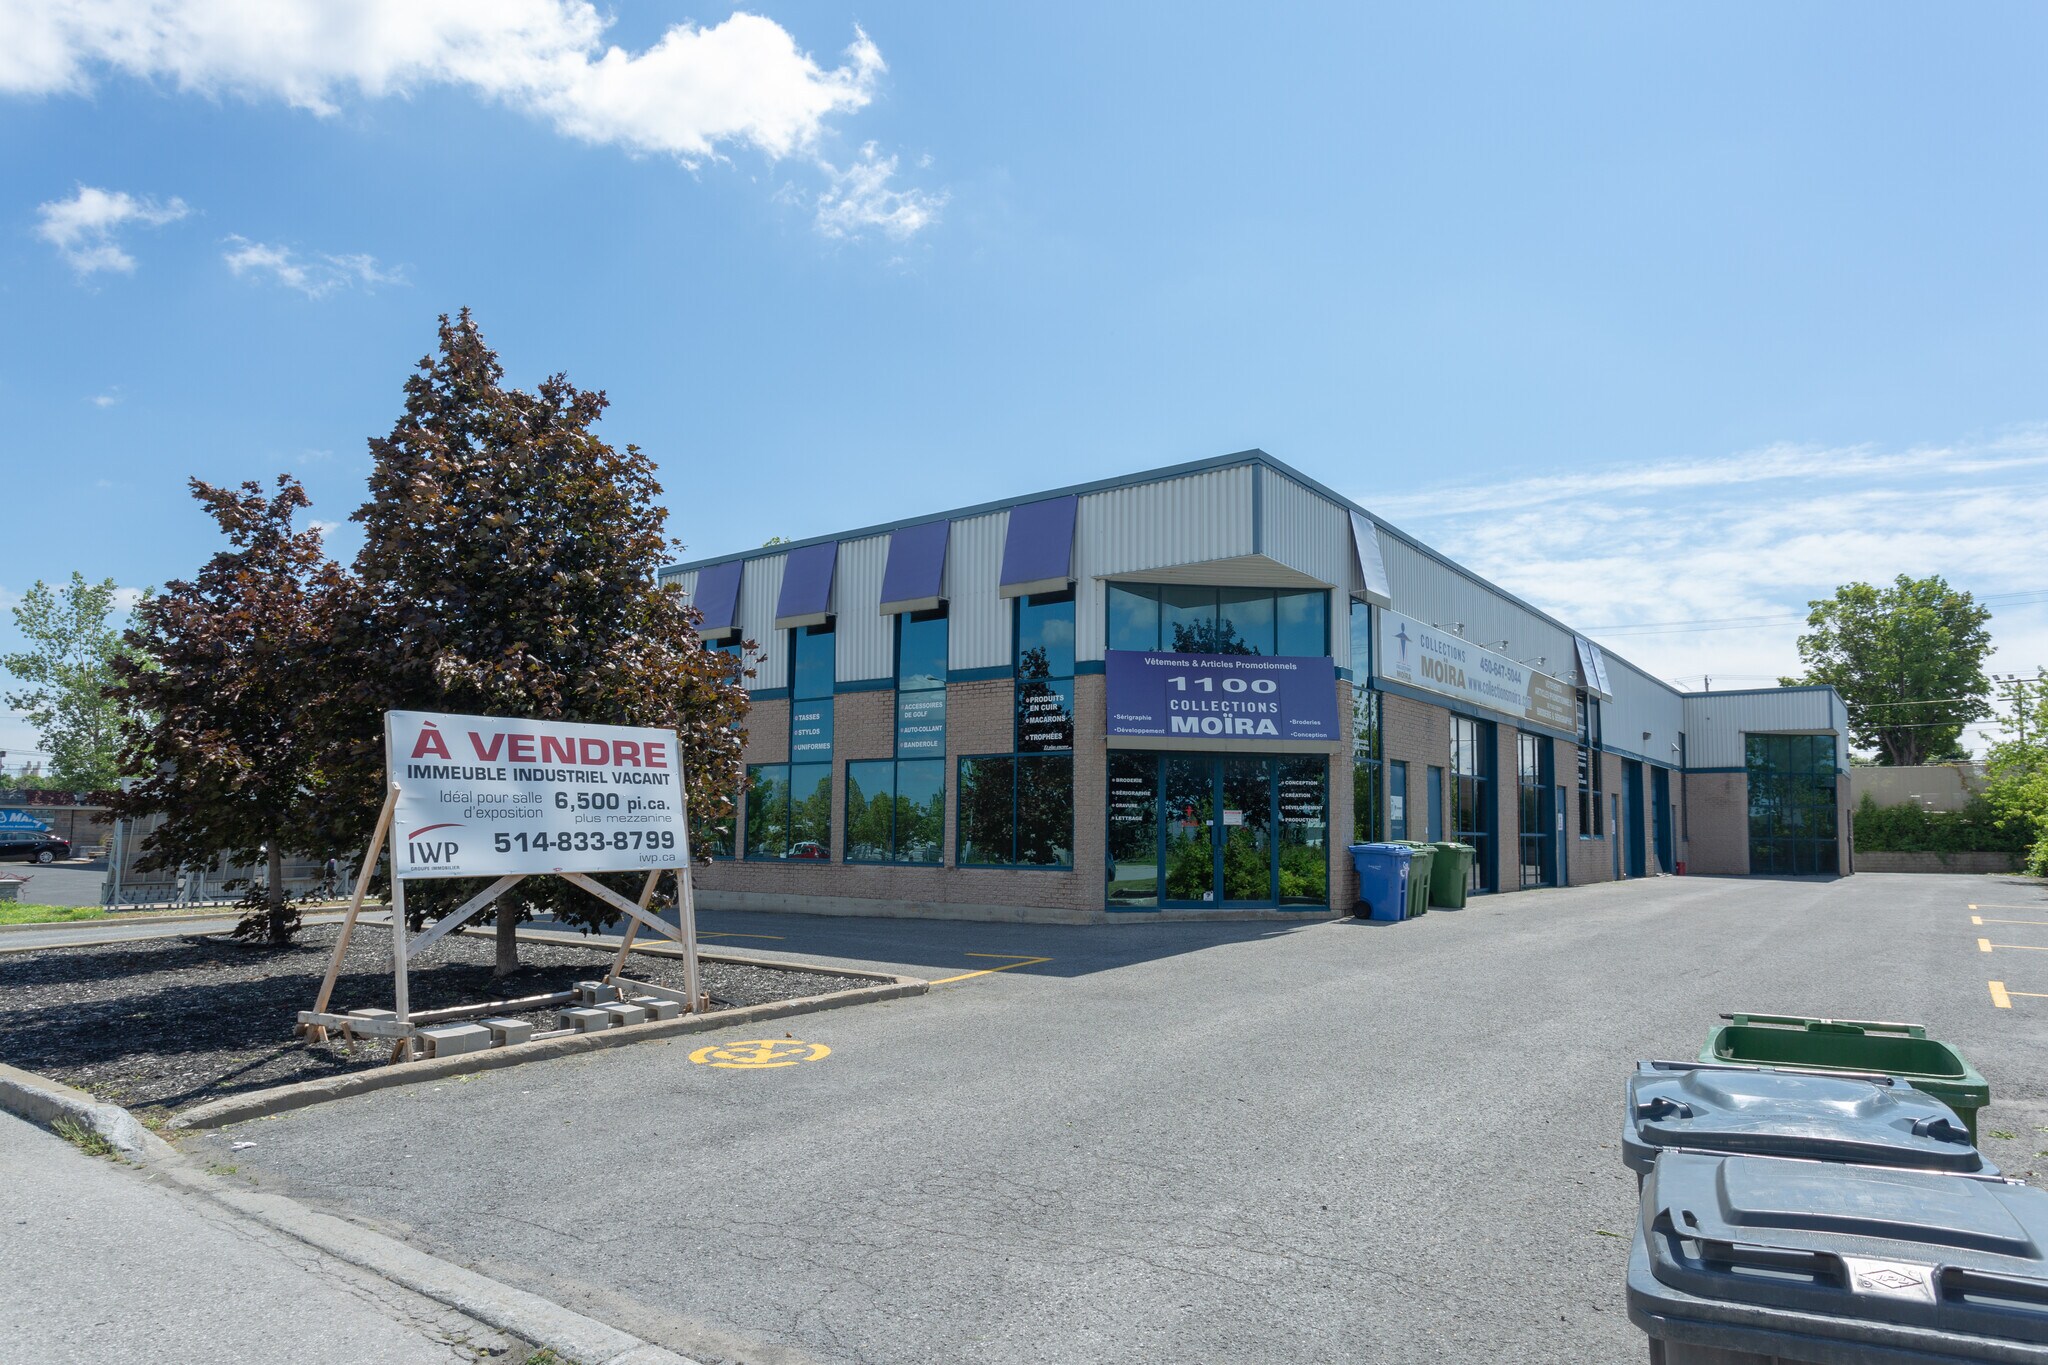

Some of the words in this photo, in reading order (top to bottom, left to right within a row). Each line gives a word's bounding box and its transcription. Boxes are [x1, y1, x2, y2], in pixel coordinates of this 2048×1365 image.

[1420, 634, 1466, 664] COLLECTIONS
[1144, 657, 1190, 667] Vêtements
[1200, 660, 1234, 668] Articles
[1235, 661, 1298, 670] Promotionnels
[1421, 655, 1466, 690] MOÏRA
[1480, 657, 1522, 684] 450-647-5044
[1167, 676, 1277, 694] 1100
[1030, 695, 1064, 703] PRODUITS
[904, 702, 943, 710] ACCESSOIRES
[1170, 699, 1278, 713] COLLECTIONS
[799, 713, 820, 721] TASSES
[904, 711, 912, 719] DE
[1030, 715, 1066, 724] MACARONS
[904, 725, 943, 733] AUTO-COLLANT
[1171, 713, 1279, 735] MOÏRA
[798, 728, 821, 736] STYLOS
[1030, 732, 1063, 741] TROPHÉES
[411, 720, 452, 760] À
[467, 731, 668, 768] VENDRE
[797, 742, 831, 750] UNIFORMES
[904, 740, 938, 748] BANDEROLE
[407, 764, 507, 781] IMMEUBLE
[513, 768, 608, 784] INDUSTRIEL
[612, 771, 670, 785] VACANT
[440, 790, 473, 803] Idéal
[477, 793, 508, 806] pour
[512, 792, 543, 803] salle
[555, 792, 620, 812] 6,500
[627, 796, 670, 813] pi.ca.
[463, 806, 543, 821] d'exposition
[575, 814, 602, 824] plus
[606, 815, 672, 823] mezzanine
[494, 831, 675, 853] 514-833-8799
[408, 842, 459, 864] IWP
[639, 853, 676, 864] iwp.ca
